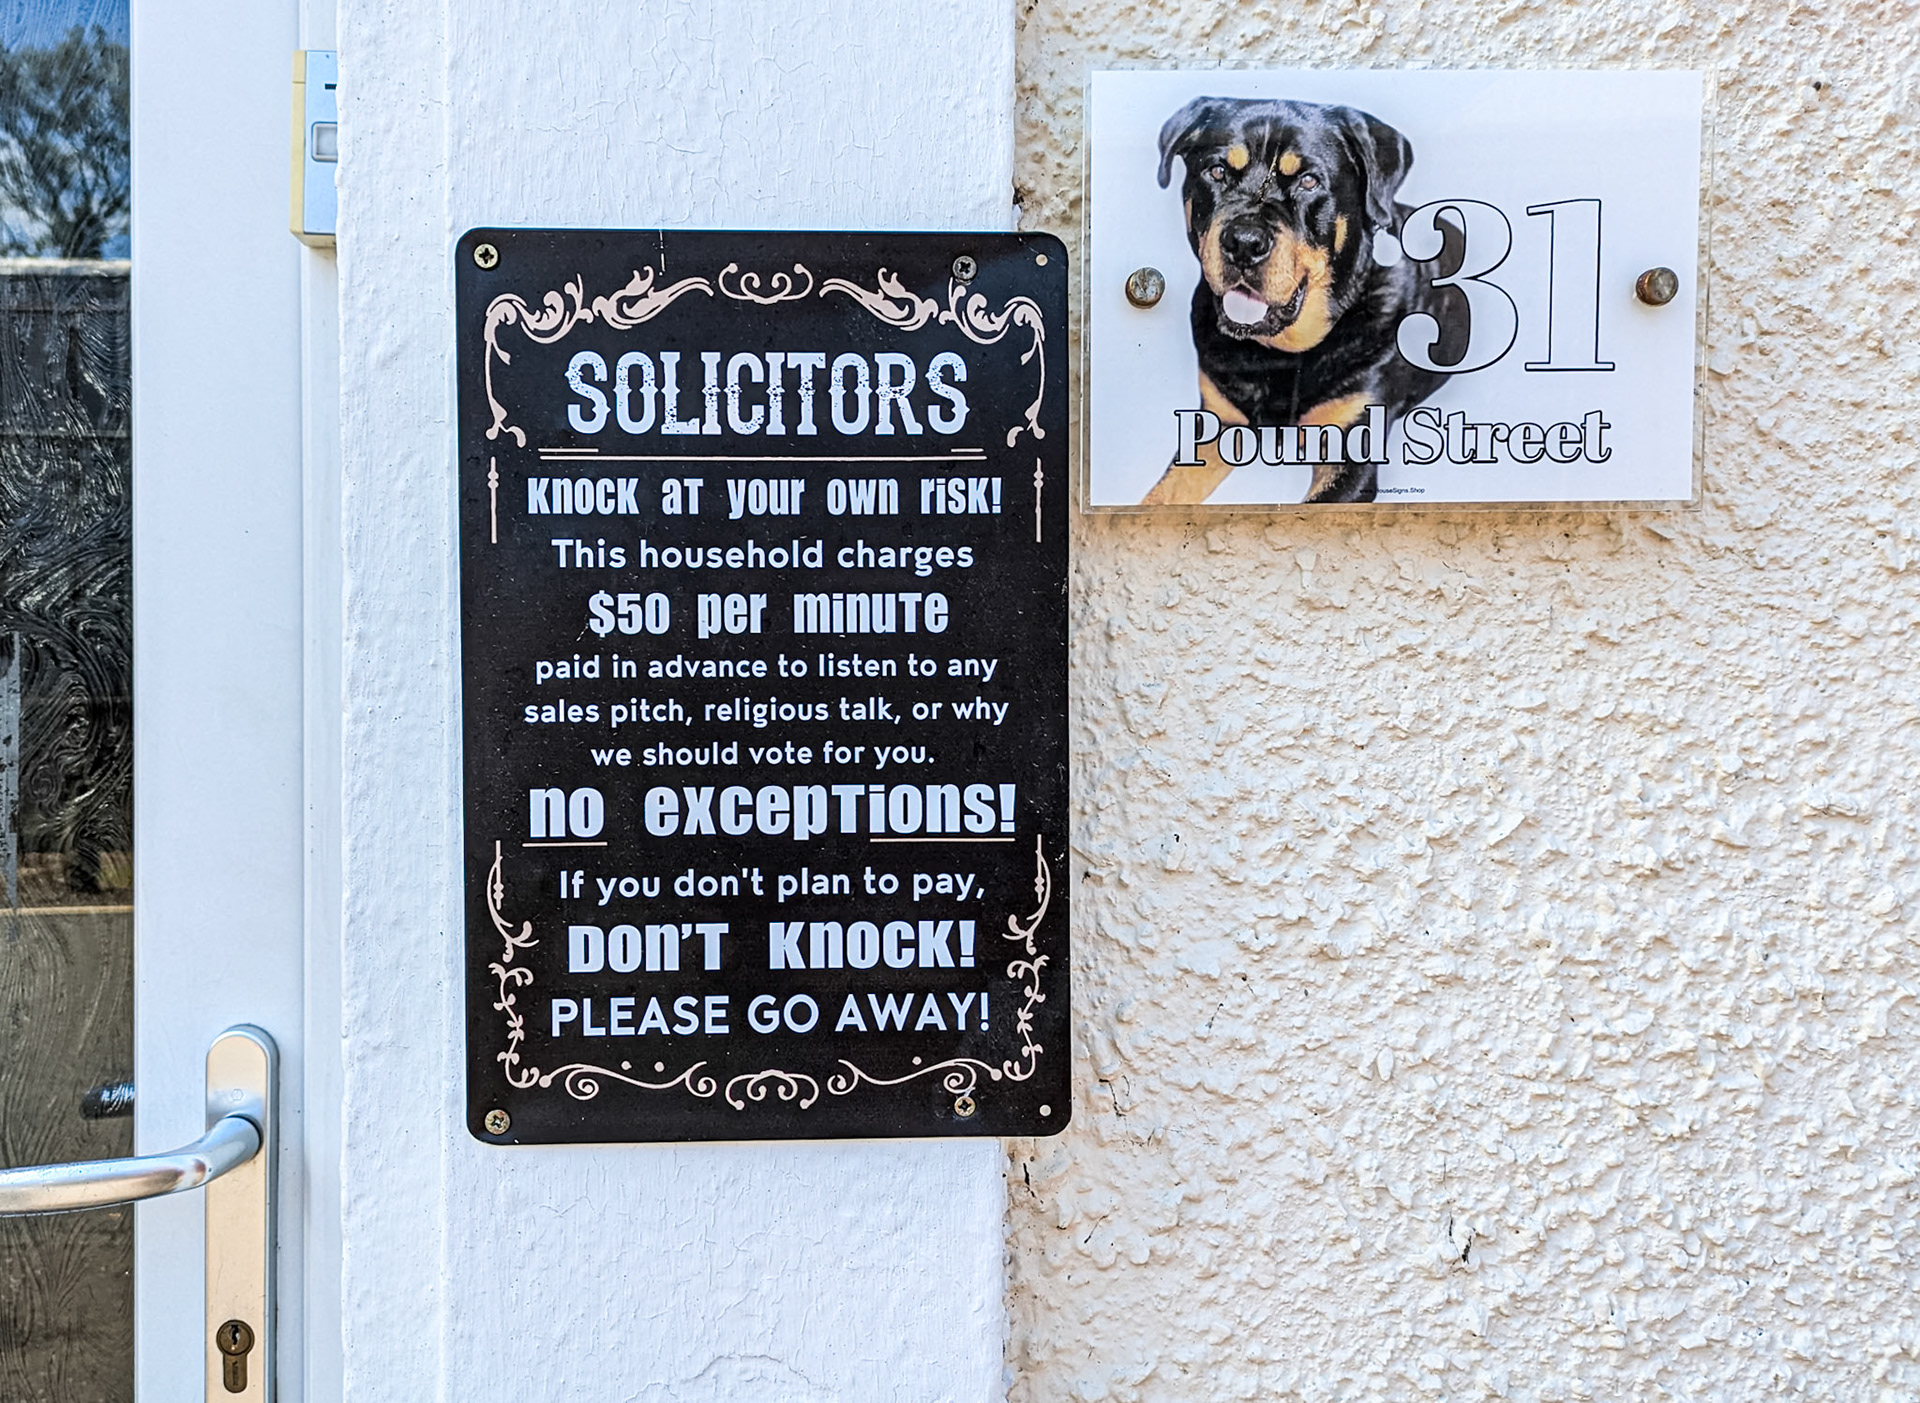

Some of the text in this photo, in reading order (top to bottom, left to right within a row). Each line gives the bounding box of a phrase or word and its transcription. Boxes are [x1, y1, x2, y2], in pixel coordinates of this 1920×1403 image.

[1396, 198, 1615, 374] 31
[564, 350, 971, 436] SOLICITORS
[1174, 404, 1612, 467] Pound Street
[551, 539, 974, 577] This household charges
[588, 589, 671, 638] $50
[697, 593, 767, 639] per
[536, 653, 998, 685] paid in advance to listen to any
[524, 696, 1009, 728] sales pitch, religious talk, or why
[590, 740, 935, 770] we should vote for you.
[560, 867, 985, 906] If you don't plan to pay,
[551, 992, 990, 1037] PLEASE GO AWAY!
